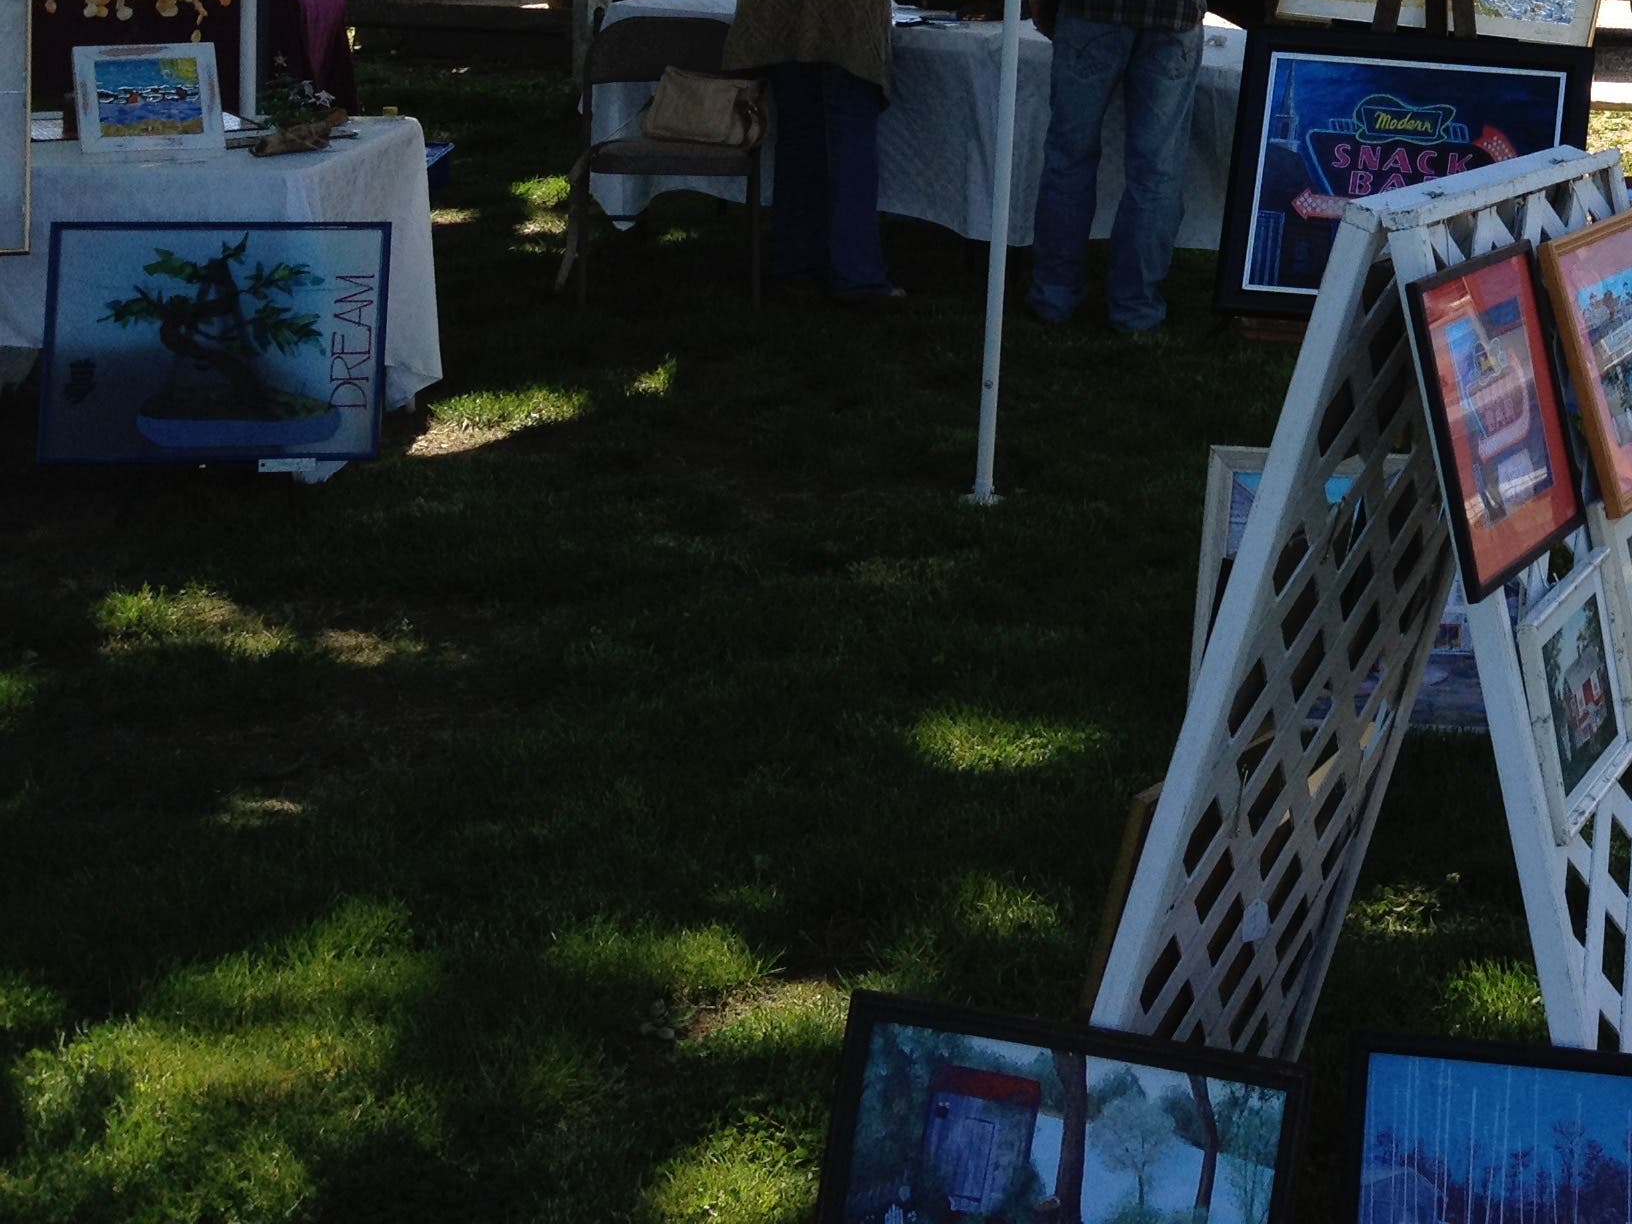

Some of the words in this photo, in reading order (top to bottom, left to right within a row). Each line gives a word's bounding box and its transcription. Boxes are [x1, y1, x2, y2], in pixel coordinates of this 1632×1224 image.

[1374, 111, 1433, 133] Modern
[1331, 143, 1473, 176] SNACK
[1348, 170, 1437, 196] BA
[328, 274, 375, 409] DREAM
